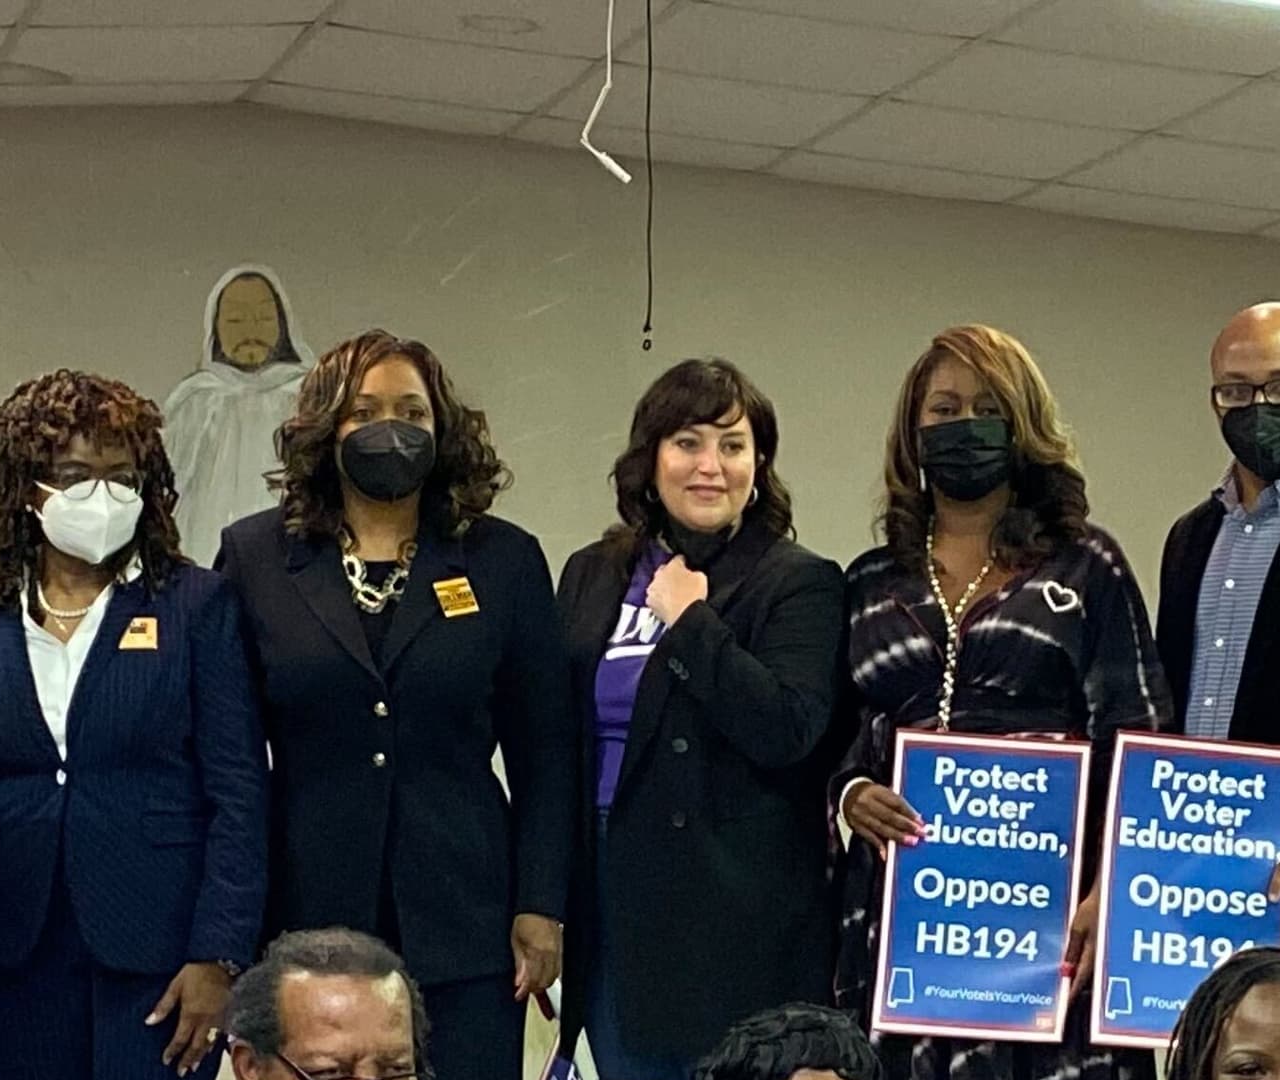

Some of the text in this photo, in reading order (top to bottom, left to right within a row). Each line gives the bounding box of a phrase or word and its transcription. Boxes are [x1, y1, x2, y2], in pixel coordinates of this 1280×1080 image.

[933, 757, 1050, 793] Protect
[1152, 759, 1266, 801] Protect
[945, 786, 1034, 821] Voter
[1161, 790, 1251, 828] Voter
[924, 822, 1068, 859] ducation,
[913, 867, 1051, 909] Oppose
[1128, 873, 1267, 917] Oppose
[915, 920, 1038, 962] HB194
